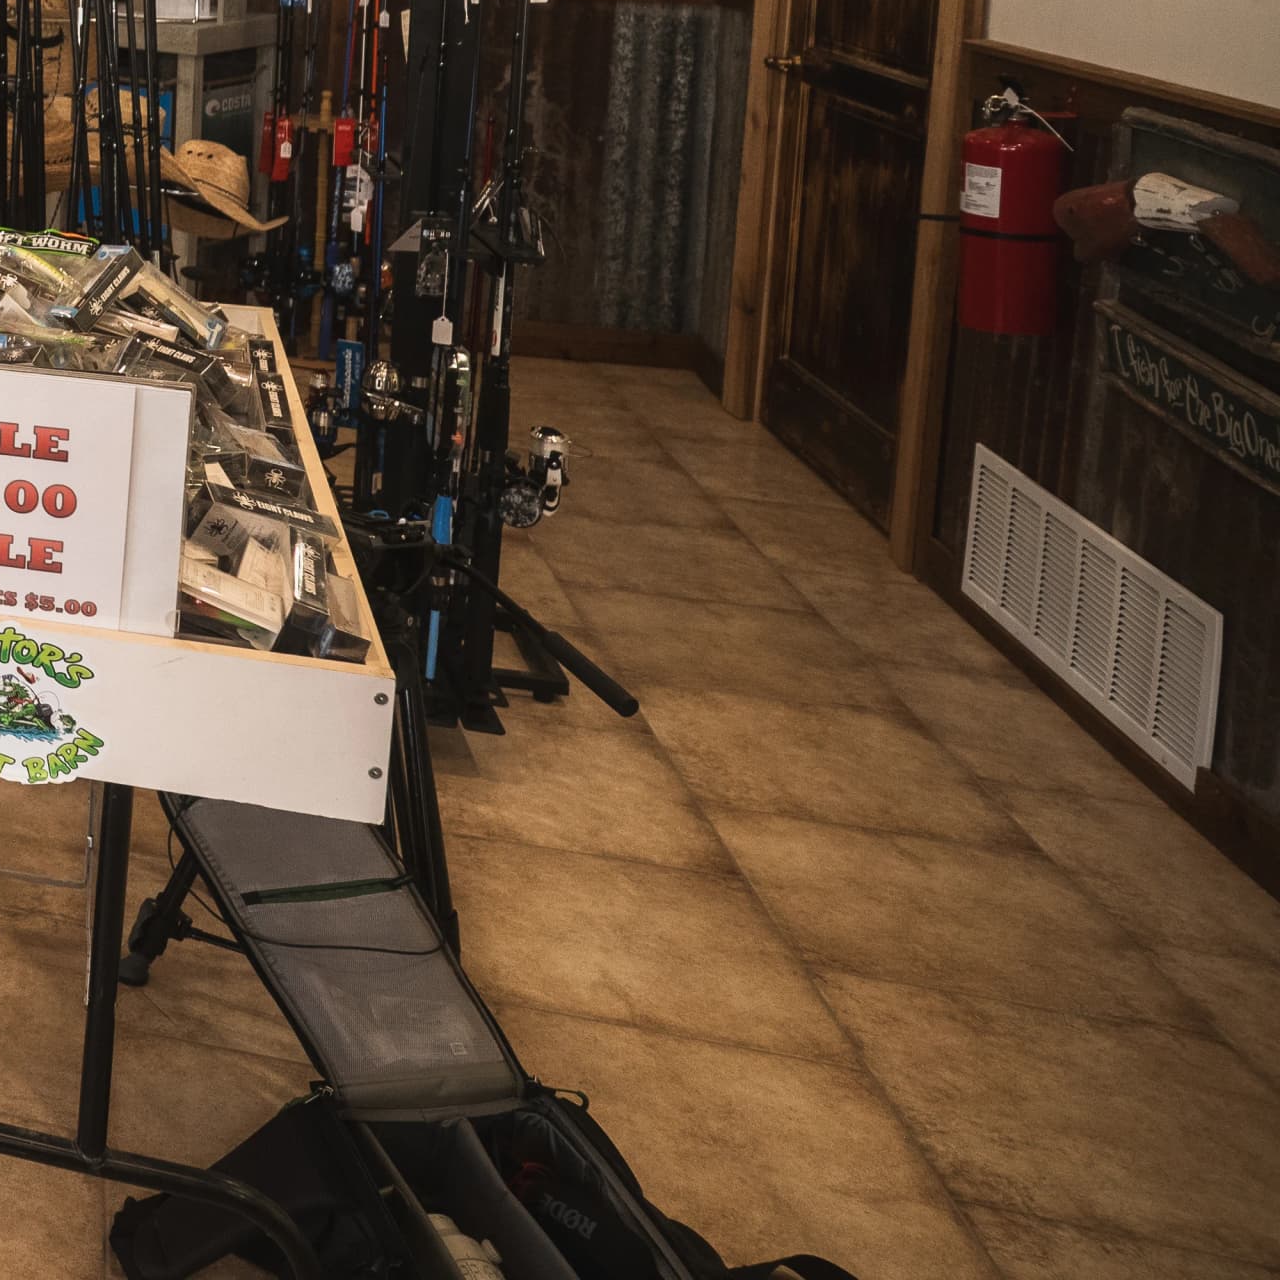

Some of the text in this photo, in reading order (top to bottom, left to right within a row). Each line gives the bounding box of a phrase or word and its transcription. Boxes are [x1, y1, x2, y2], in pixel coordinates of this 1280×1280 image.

[31, 234, 91, 255] WORM
[1110, 324, 1130, 378] I
[1127, 334, 1160, 399] fish
[1158, 356, 1184, 408] for
[1211, 391, 1246, 458] Big
[256, 500, 315, 524] EIGHT CLAWS
[24, 591, 98, 617] $5.00
[21, 727, 105, 784] BARN
